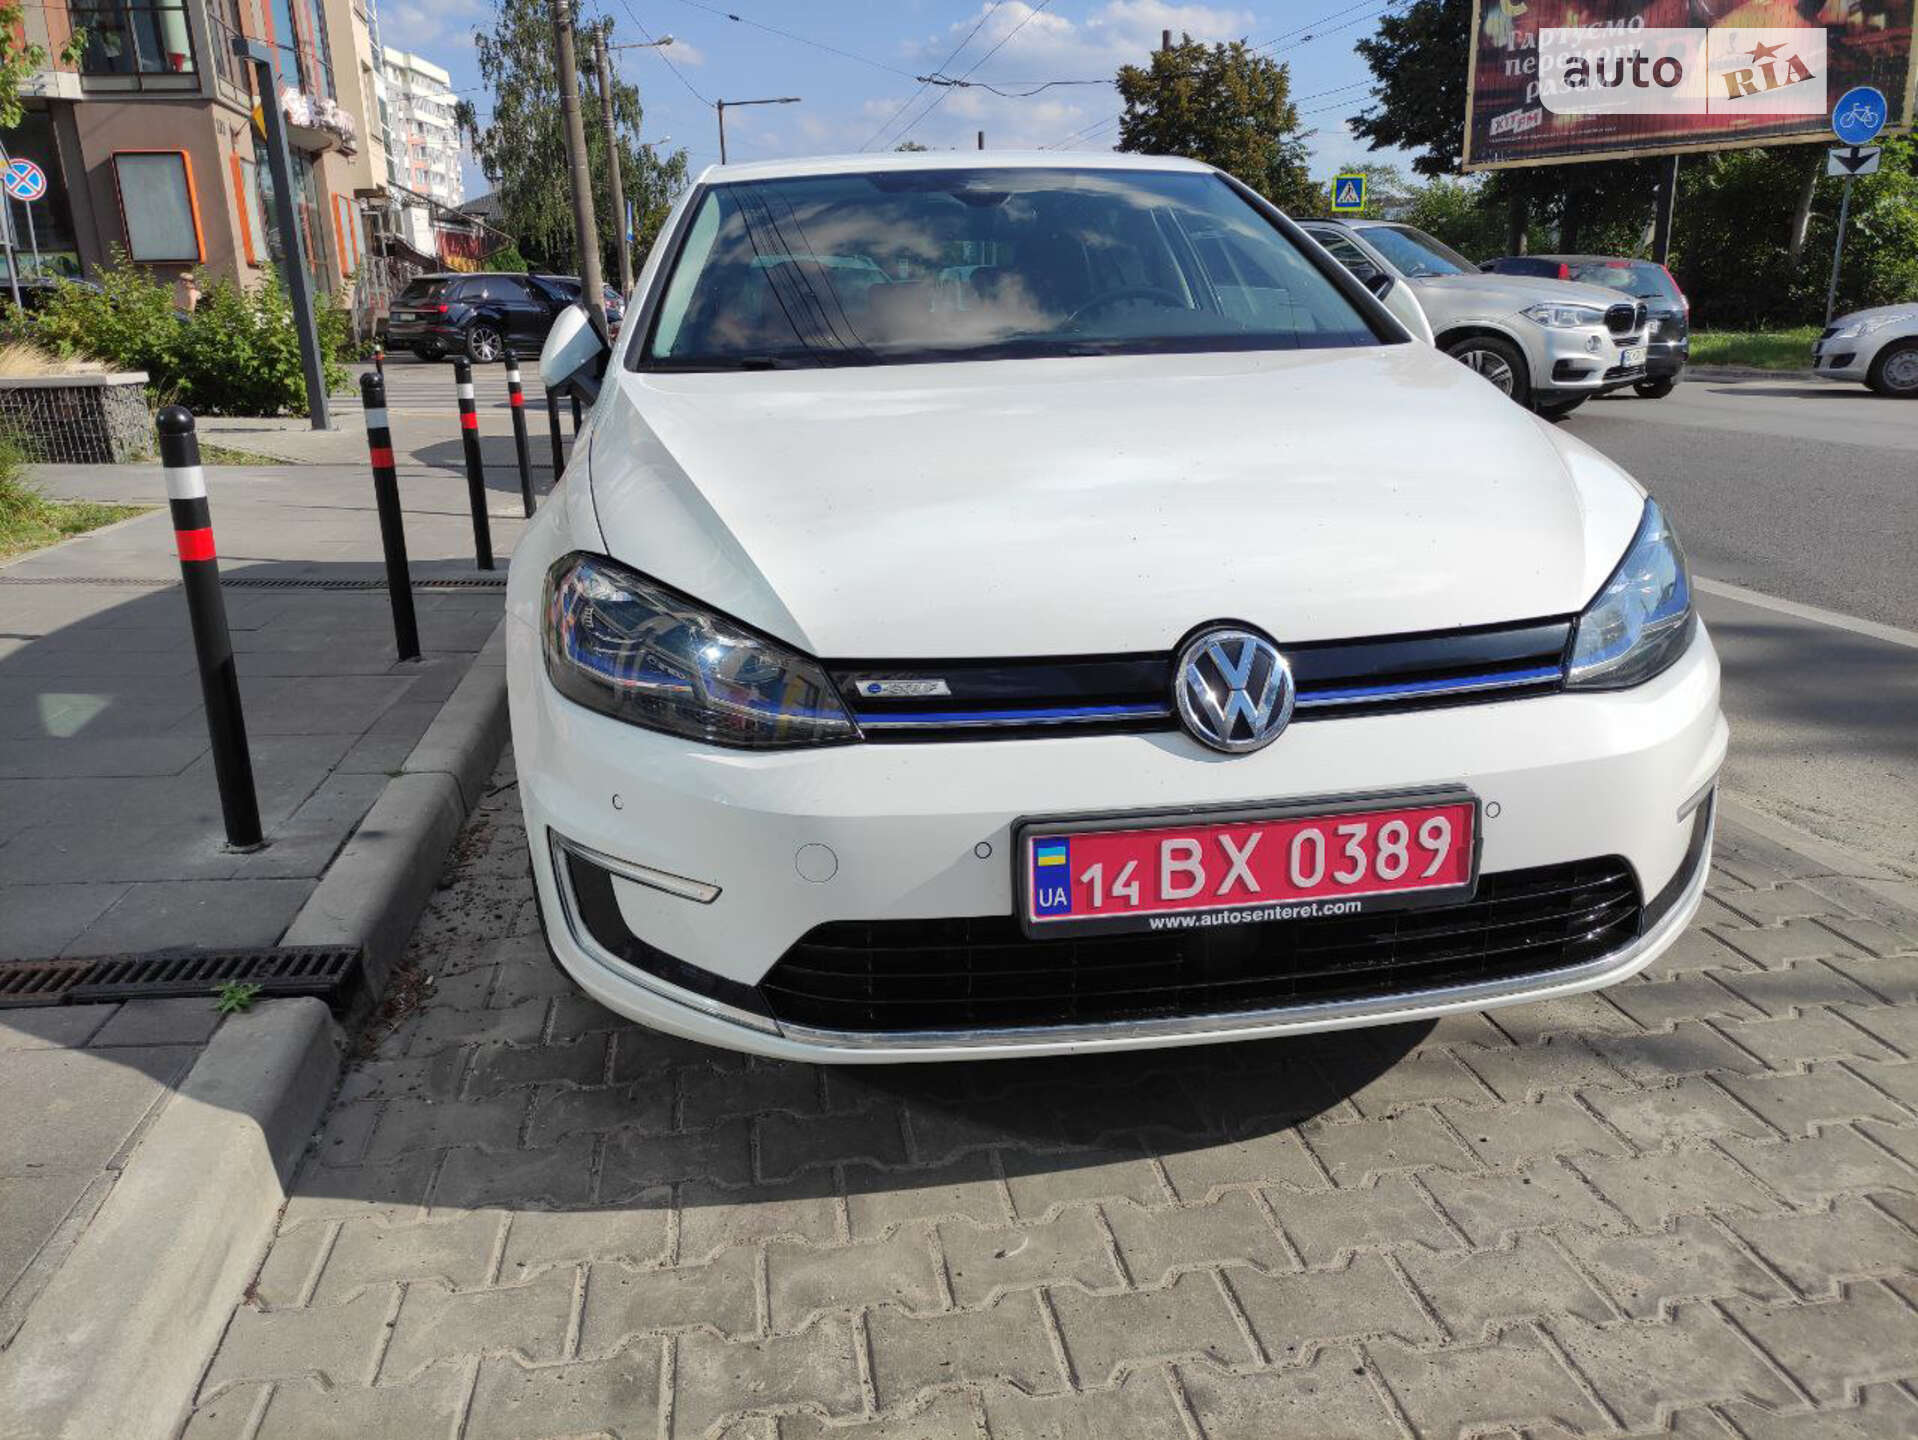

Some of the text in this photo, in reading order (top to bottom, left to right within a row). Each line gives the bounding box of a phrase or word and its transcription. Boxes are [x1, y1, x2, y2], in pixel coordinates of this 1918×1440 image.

[1039, 887, 1067, 907] UA
[1080, 860, 1140, 907] 14
[1290, 816, 1452, 888] 0389
[1150, 900, 1362, 930] www.autosenteret.com
